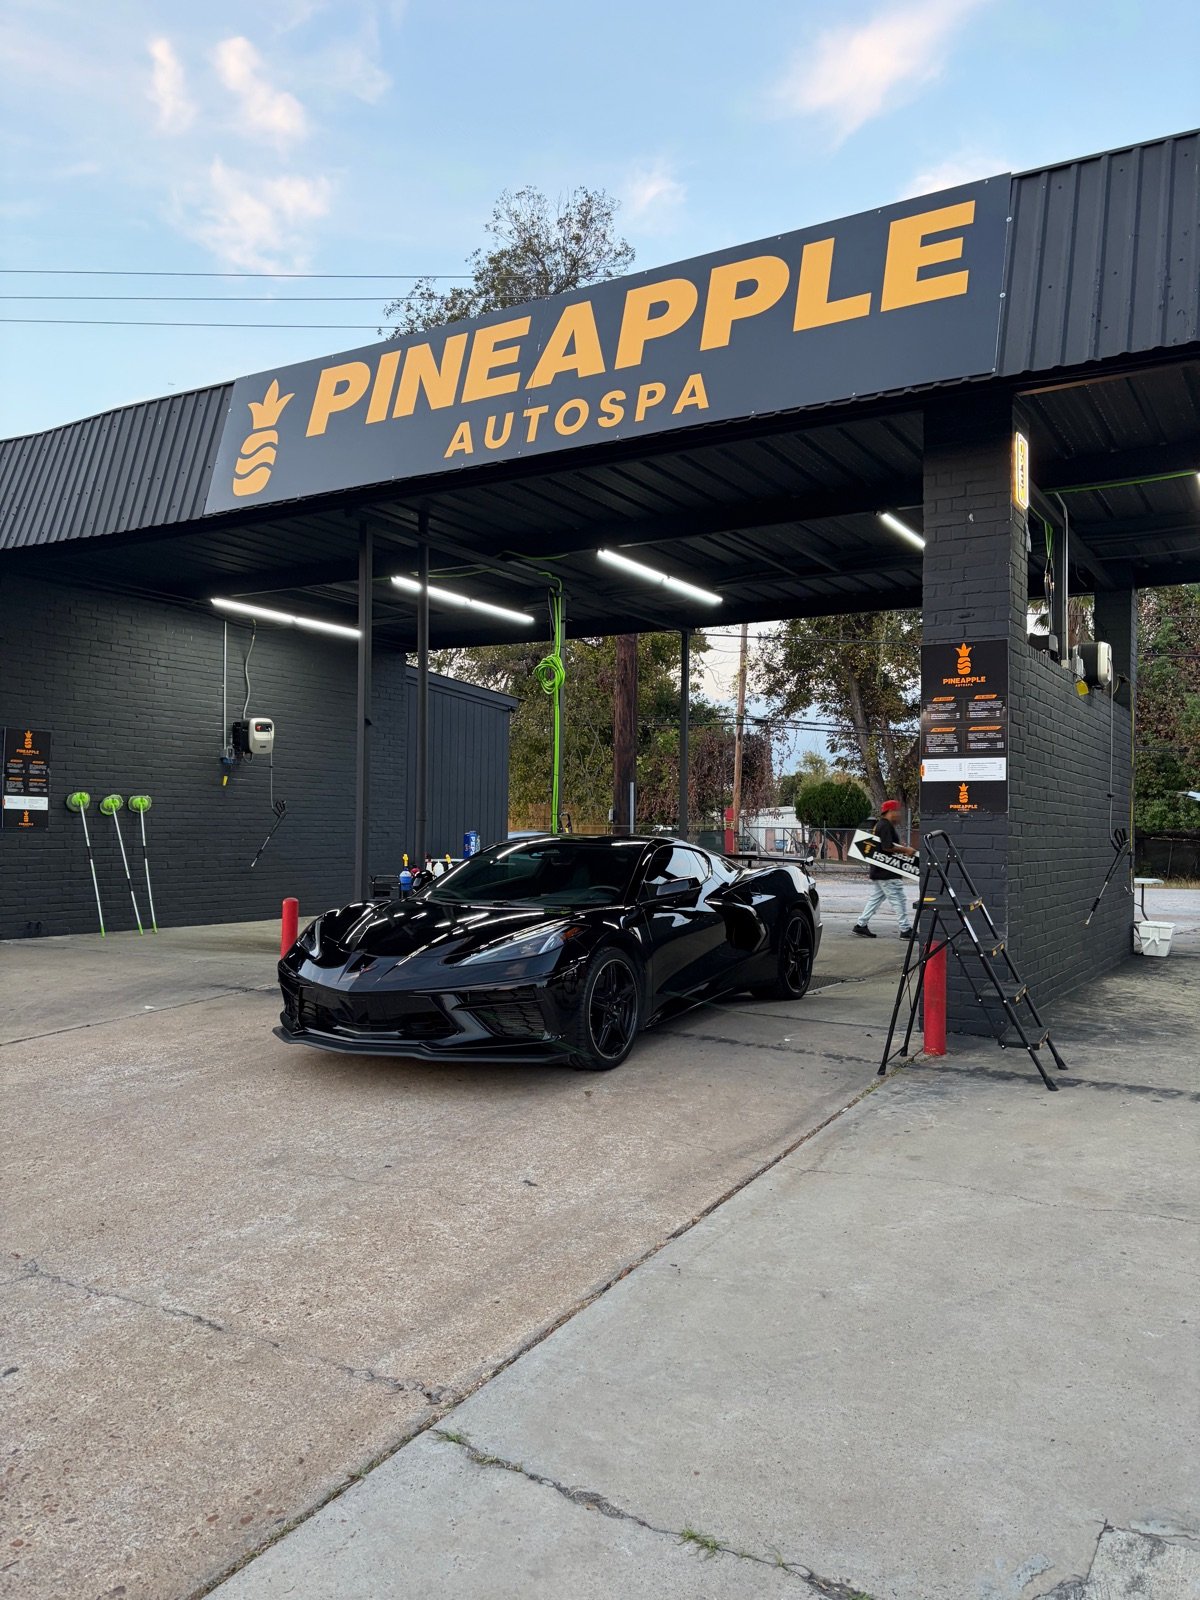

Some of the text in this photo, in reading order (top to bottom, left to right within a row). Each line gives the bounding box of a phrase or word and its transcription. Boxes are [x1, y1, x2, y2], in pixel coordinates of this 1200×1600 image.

[306, 200, 976, 438] PINEAPPLE
[444, 372, 710, 459] AUTOSPA
[942, 676, 986, 685] PINEAPPLE
[872, 851, 920, 875] AND WASH
